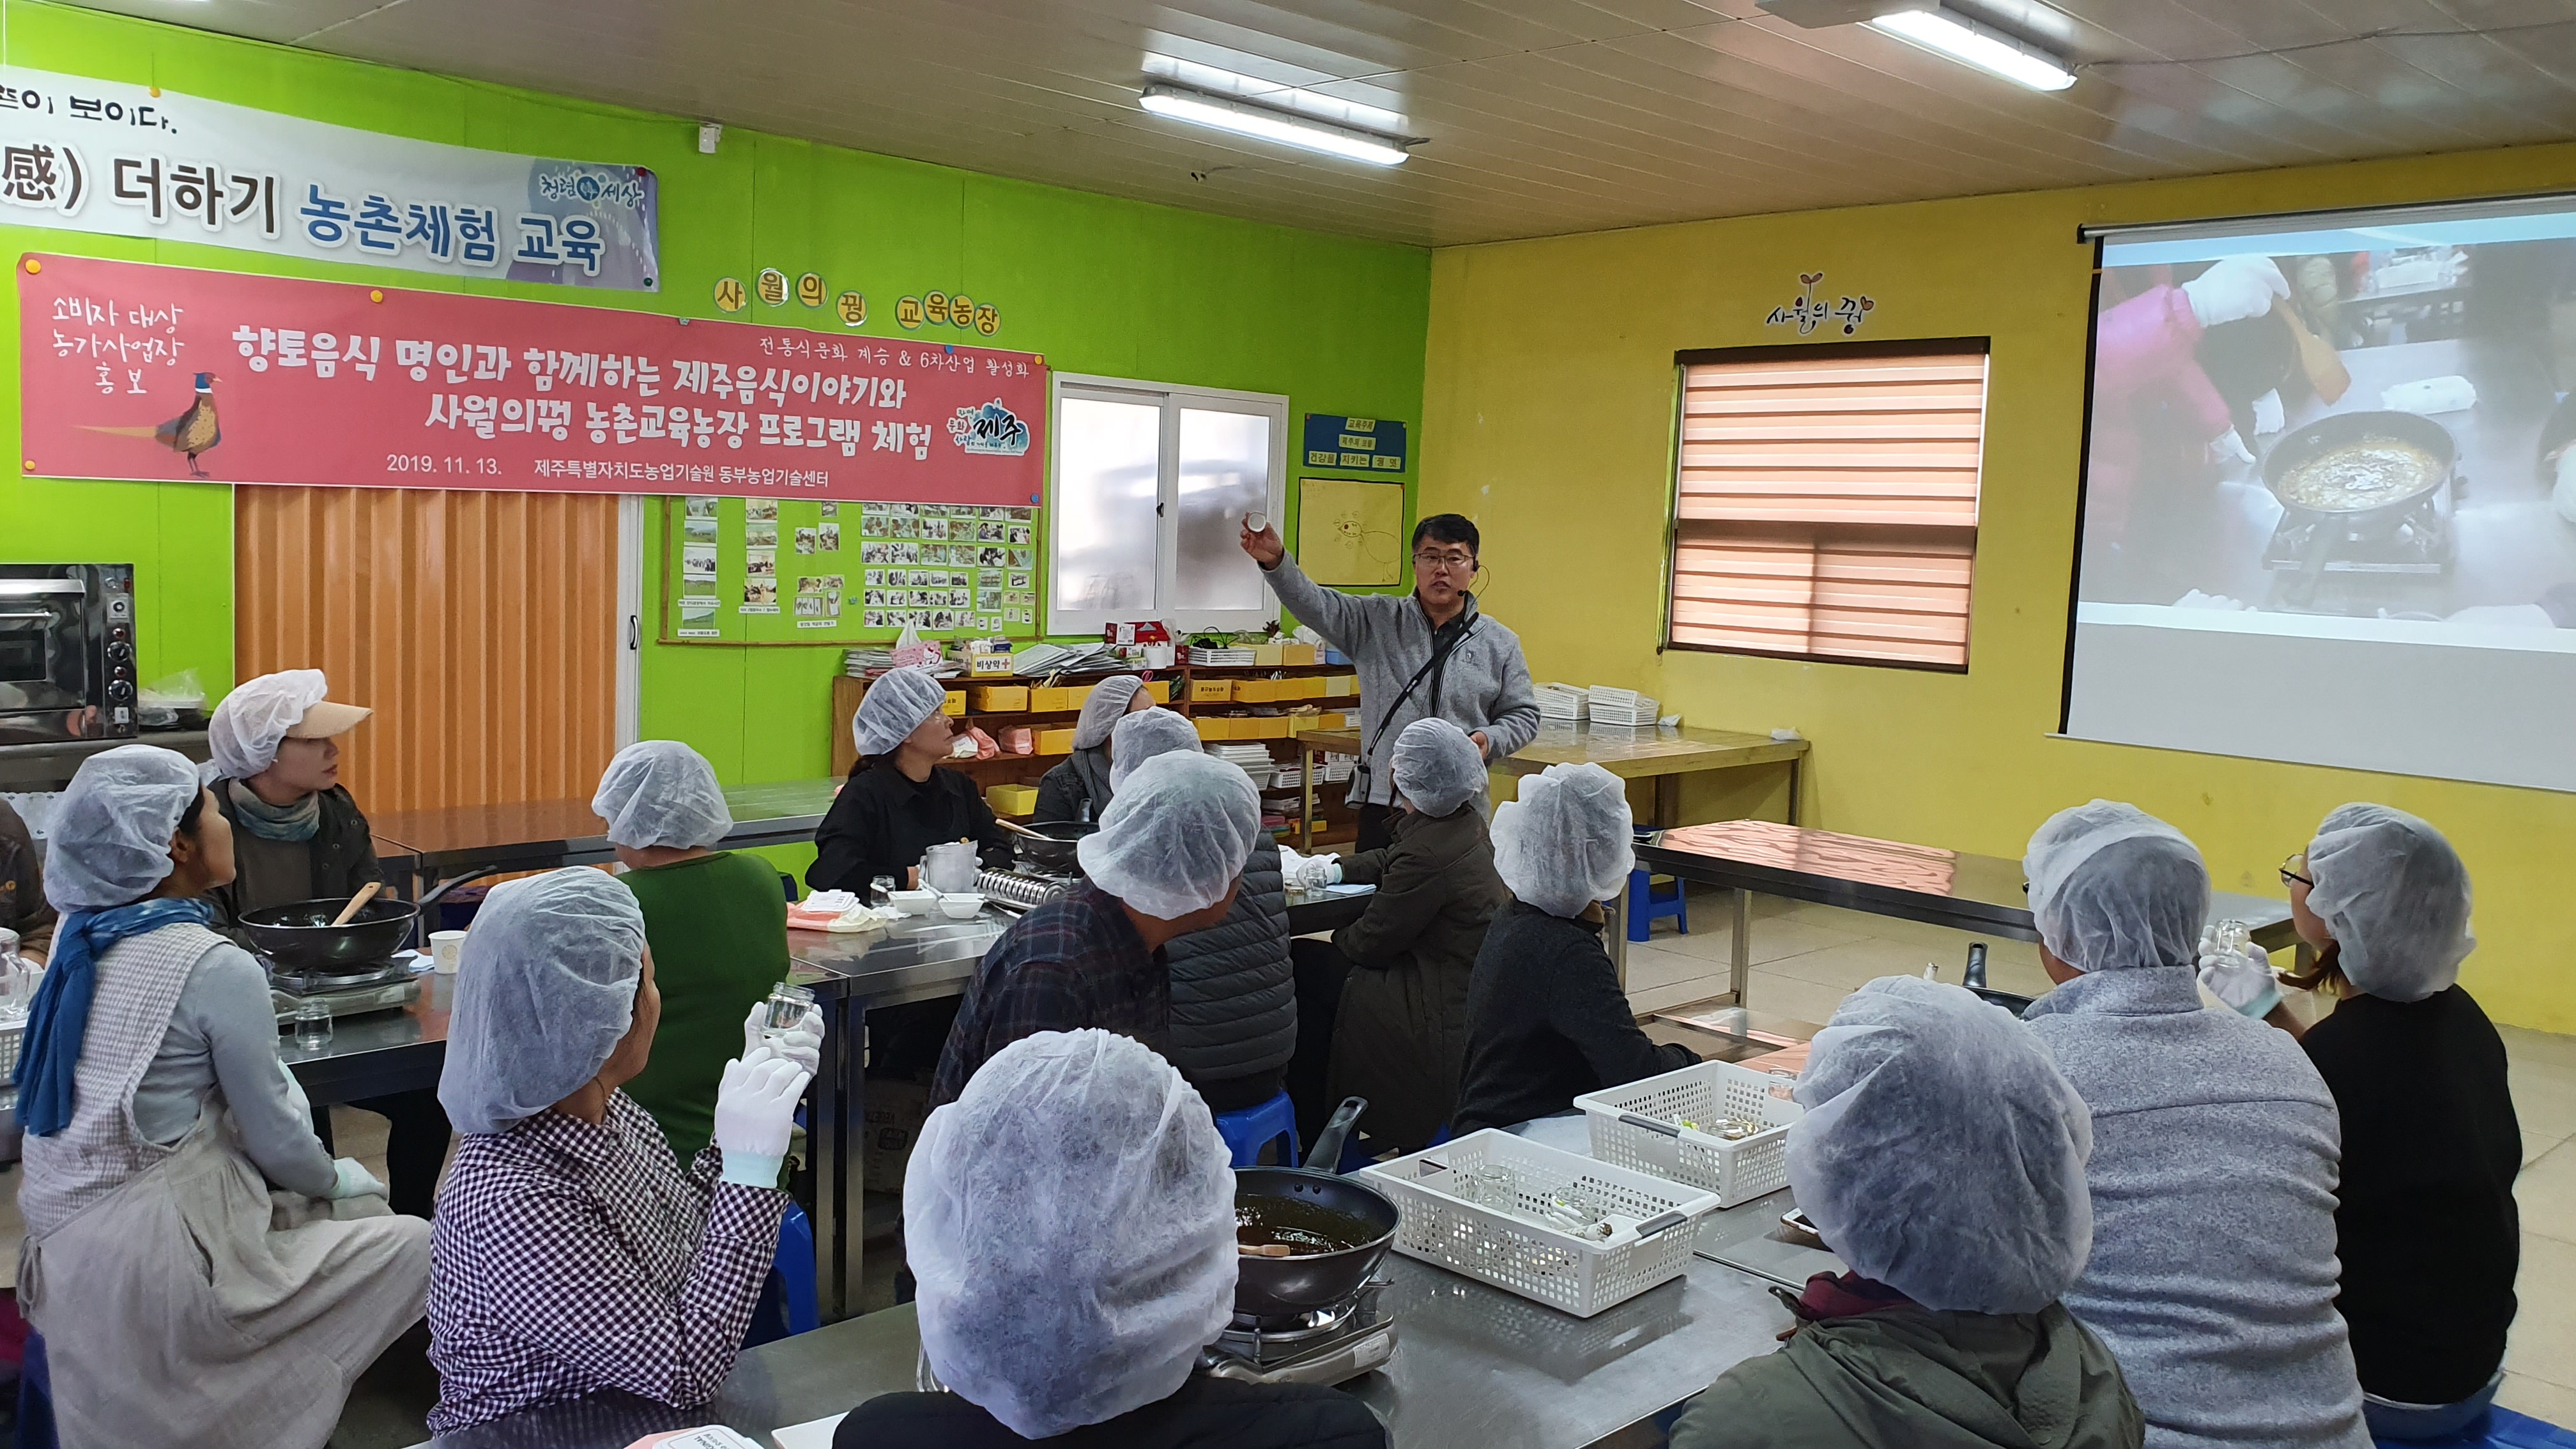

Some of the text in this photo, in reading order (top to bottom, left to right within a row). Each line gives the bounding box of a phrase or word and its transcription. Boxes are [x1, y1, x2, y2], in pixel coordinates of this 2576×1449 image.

[69, 95, 178, 134] 보이다.
[114, 158, 274, 233] 더하기
[300, 184, 494, 262] 농촌체험
[518, 217, 602, 272] 교육
[52, 297, 183, 334] 소비자 대상
[900, 295, 998, 333] 교육농장
[52, 329, 185, 366] 농가사업장
[858, 346, 890, 365] 계승
[899, 351, 912, 367] &
[920, 355, 975, 374] 6차산업
[986, 358, 1029, 378] 활성화
[232, 325, 907, 409] 향토음식 명인과 함께하는 제주음식이야기와
[424, 394, 931, 460] 사월의꿩 농촌교육농장 프로그램 체험
[973, 414, 1022, 445] 제주
[387, 454, 437, 473] 2019.
[444, 457, 470, 474] 11.
[476, 458, 502, 475] 13.
[719, 466, 829, 487] 동부농업기술센터
[1310, 452, 1335, 464] 건강을
[1342, 454, 1367, 465] 지키는
[976, 660, 1000, 670] 비상약
